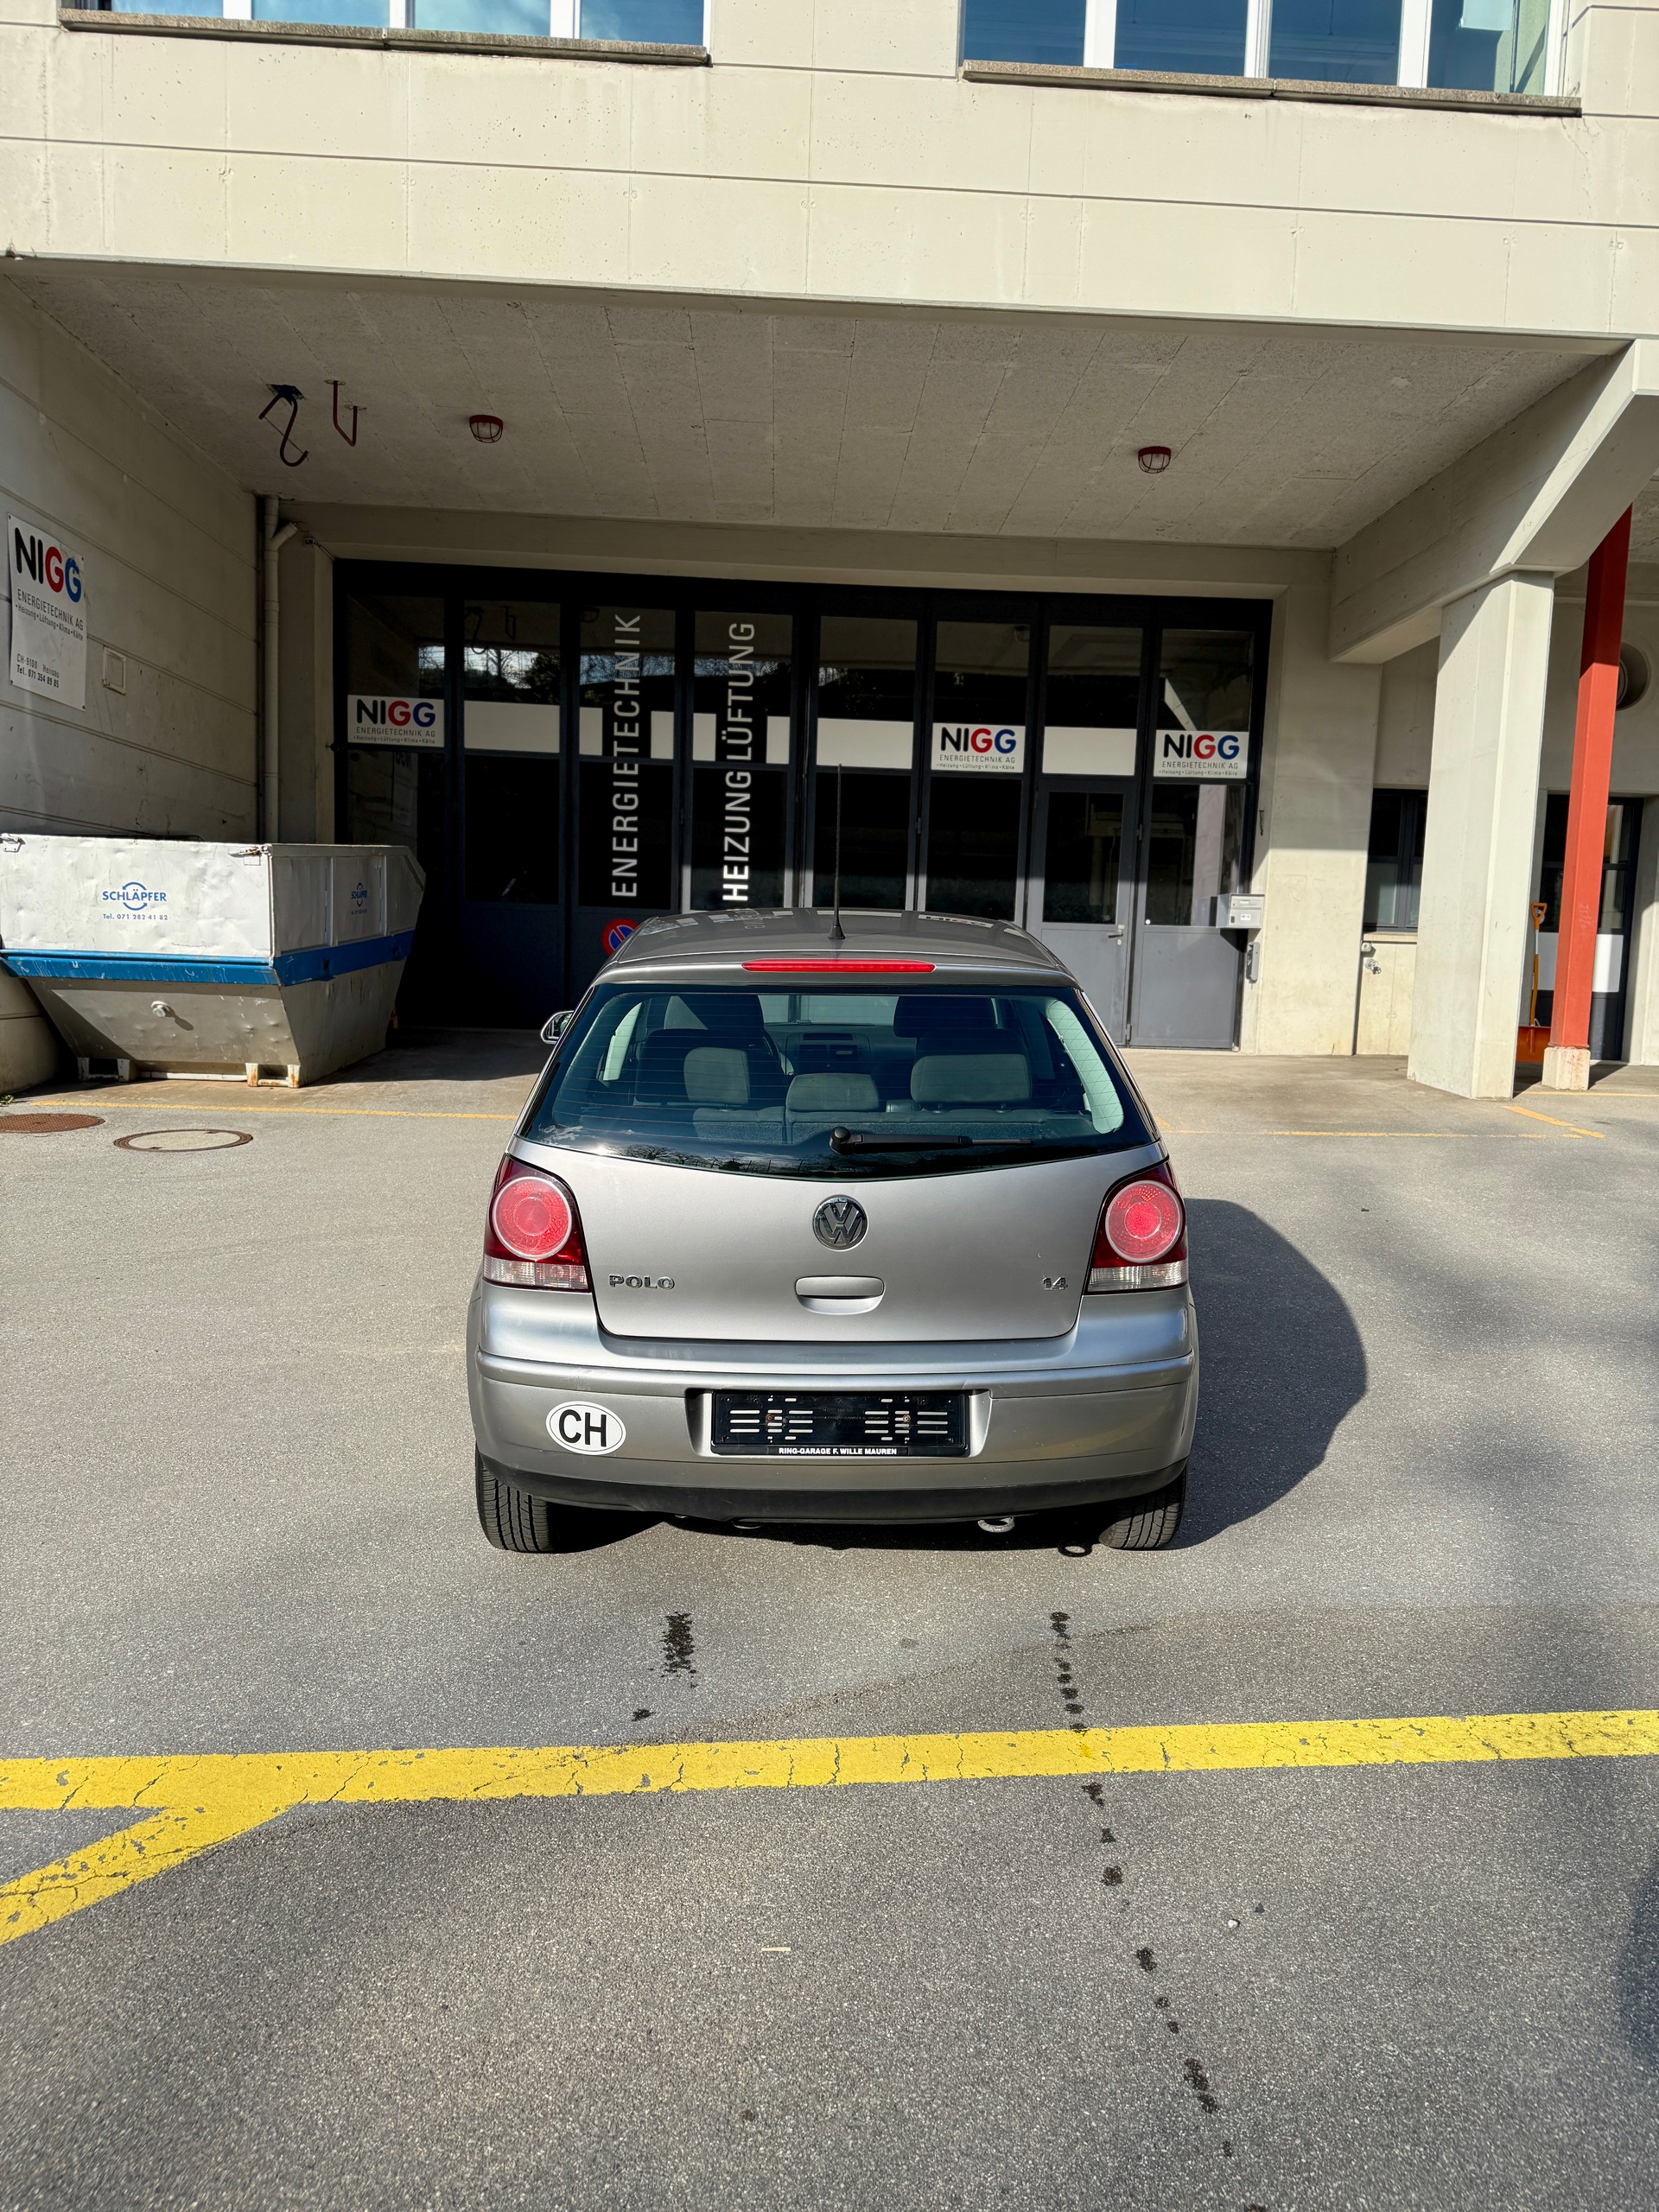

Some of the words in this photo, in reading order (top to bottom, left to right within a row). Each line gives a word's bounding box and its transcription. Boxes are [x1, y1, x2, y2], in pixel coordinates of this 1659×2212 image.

[15, 527, 82, 602] NIGG
[17, 588, 74, 626] ENERGIETECHNIK
[75, 619, 84, 631] AG
[18, 605, 36, 620] Heizung
[16, 664, 27, 676] Tel.
[28, 670, 36, 680] 071
[721, 622, 755, 761] LÜFTUNG
[357, 699, 436, 728] NIGG
[356, 727, 422, 736] ENERGIETECHNIK
[941, 727, 1017, 753] NIGG
[612, 613, 641, 897] ENERGIETECHNIK
[939, 754, 1002, 763] ENERGIETECHNIK
[1163, 734, 1240, 760] NIGG
[722, 771, 752, 901] HEIZUNG
[102, 888, 167, 901] SCHLÄPFER
[609, 1274, 676, 1290] POLO
[558, 1409, 607, 1447] CH
